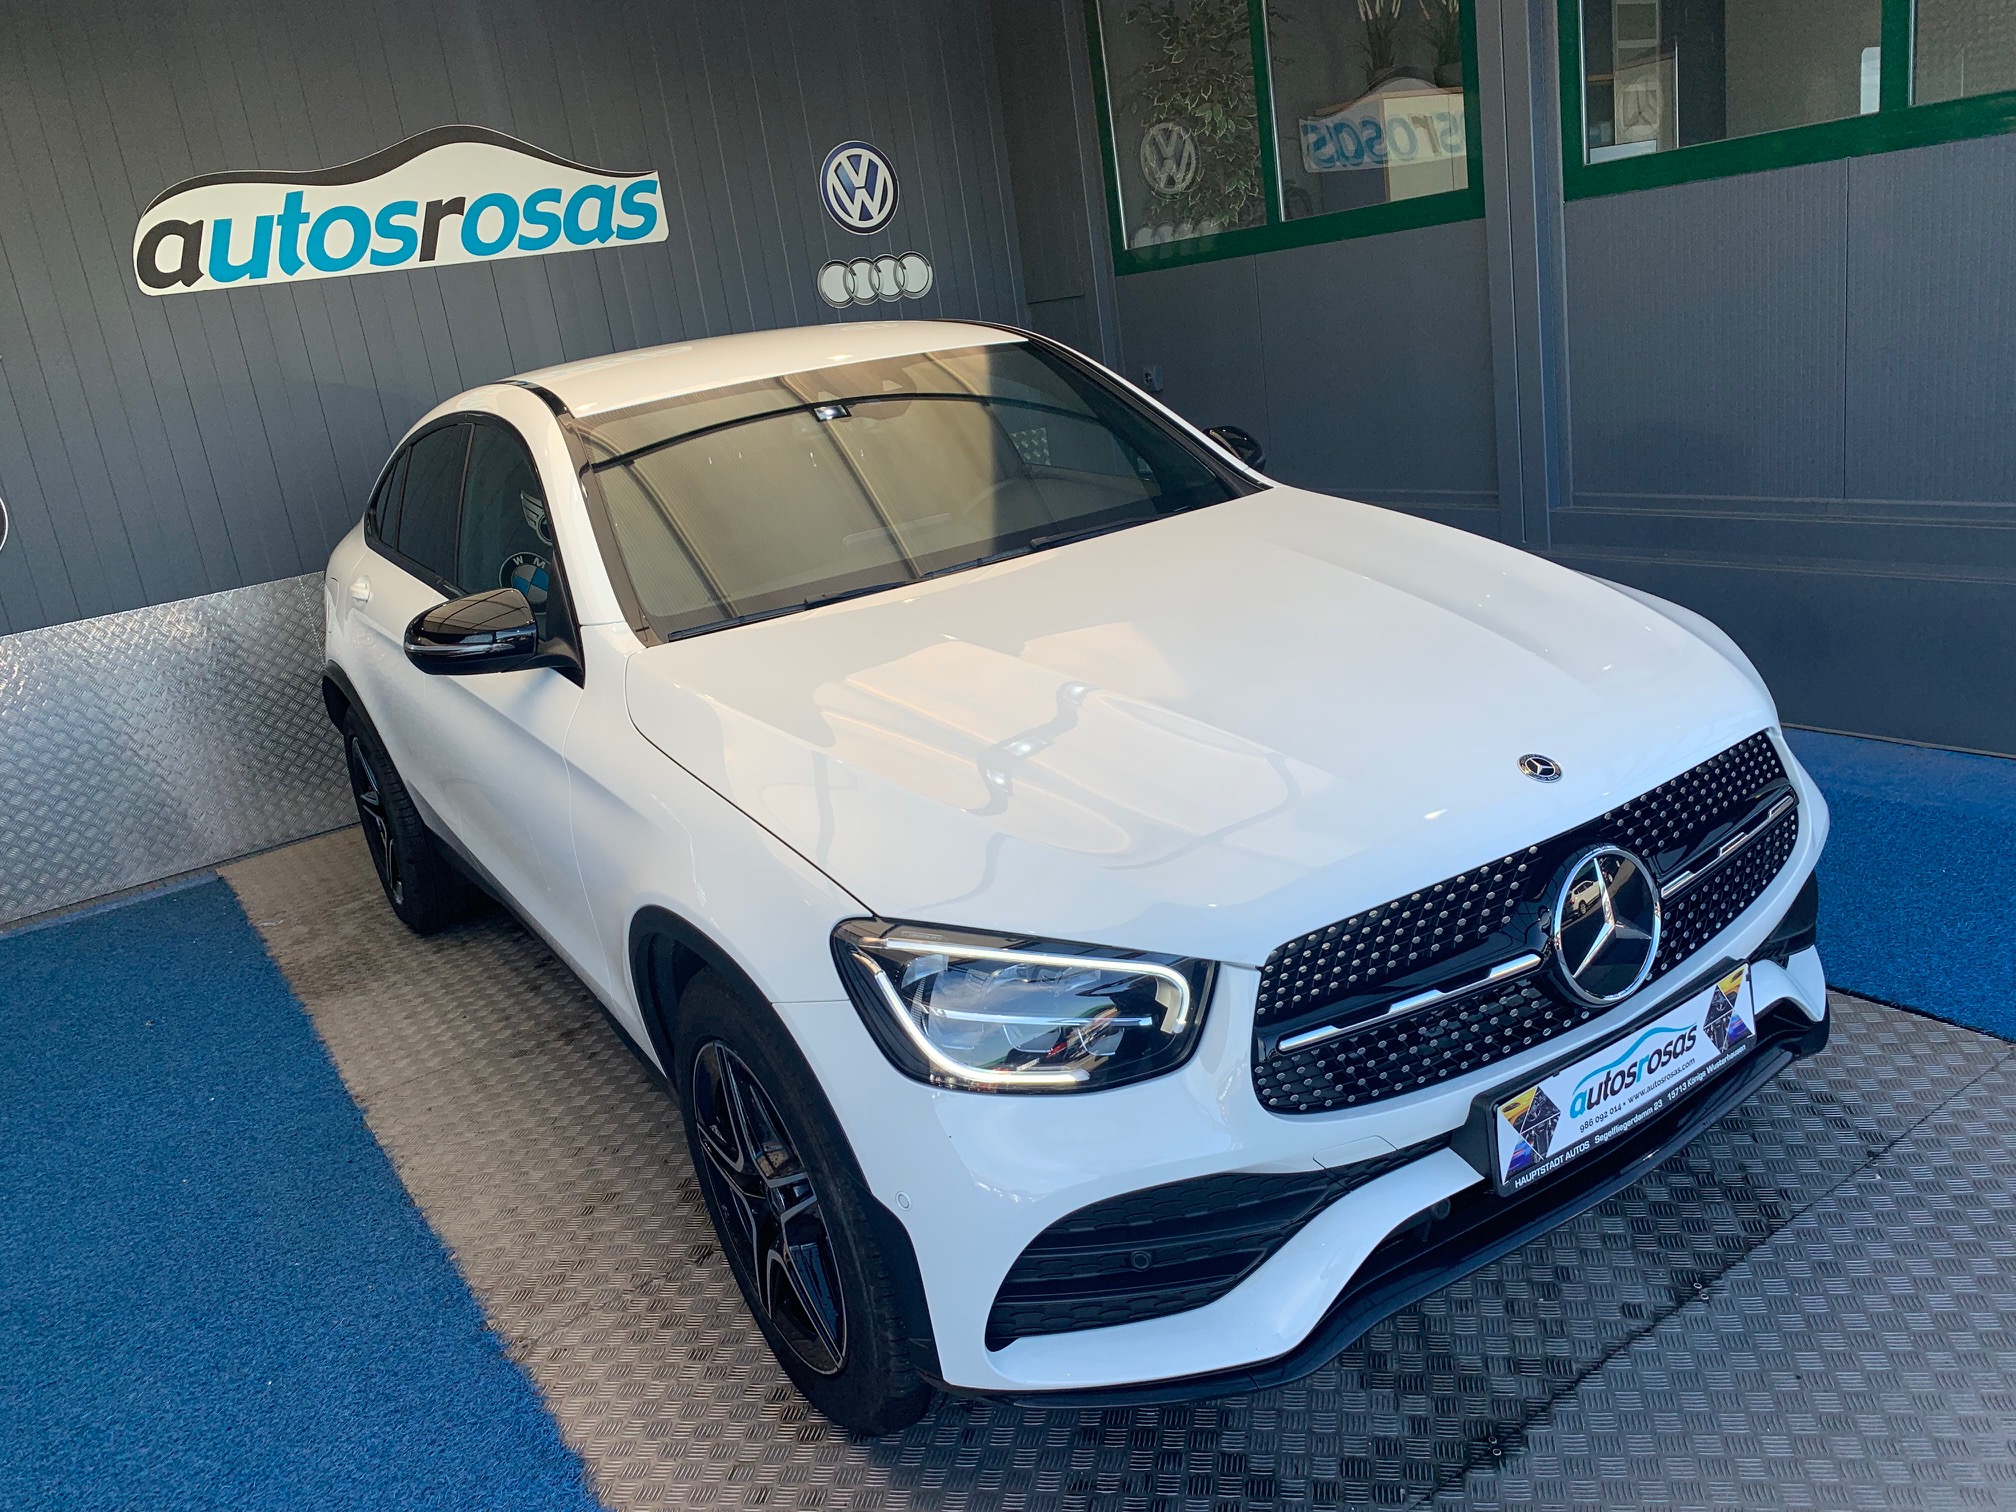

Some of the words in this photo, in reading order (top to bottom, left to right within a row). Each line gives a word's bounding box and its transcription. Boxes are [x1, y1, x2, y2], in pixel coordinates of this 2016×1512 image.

[136, 179, 658, 289] autosrosas
[1514, 1154, 1564, 1189] HAUPTSTADT
[1565, 1140, 1590, 1160] AUTOS
[1594, 1107, 1654, 1144] Segelfliegerdamm
[1653, 1098, 1663, 1112] 23
[1667, 1082, 1687, 1101] 15713
[1687, 1069, 1707, 1088] Königs
[1706, 1044, 1747, 1074] Wusterhausen
[1569, 1025, 1698, 1119] autosrosas
[1579, 1119, 1594, 1133] 986
[1594, 1111, 1608, 1124] 092
[1609, 1103, 1622, 1116] 014
[1627, 1057, 1696, 1104] www.autosrosas.com
